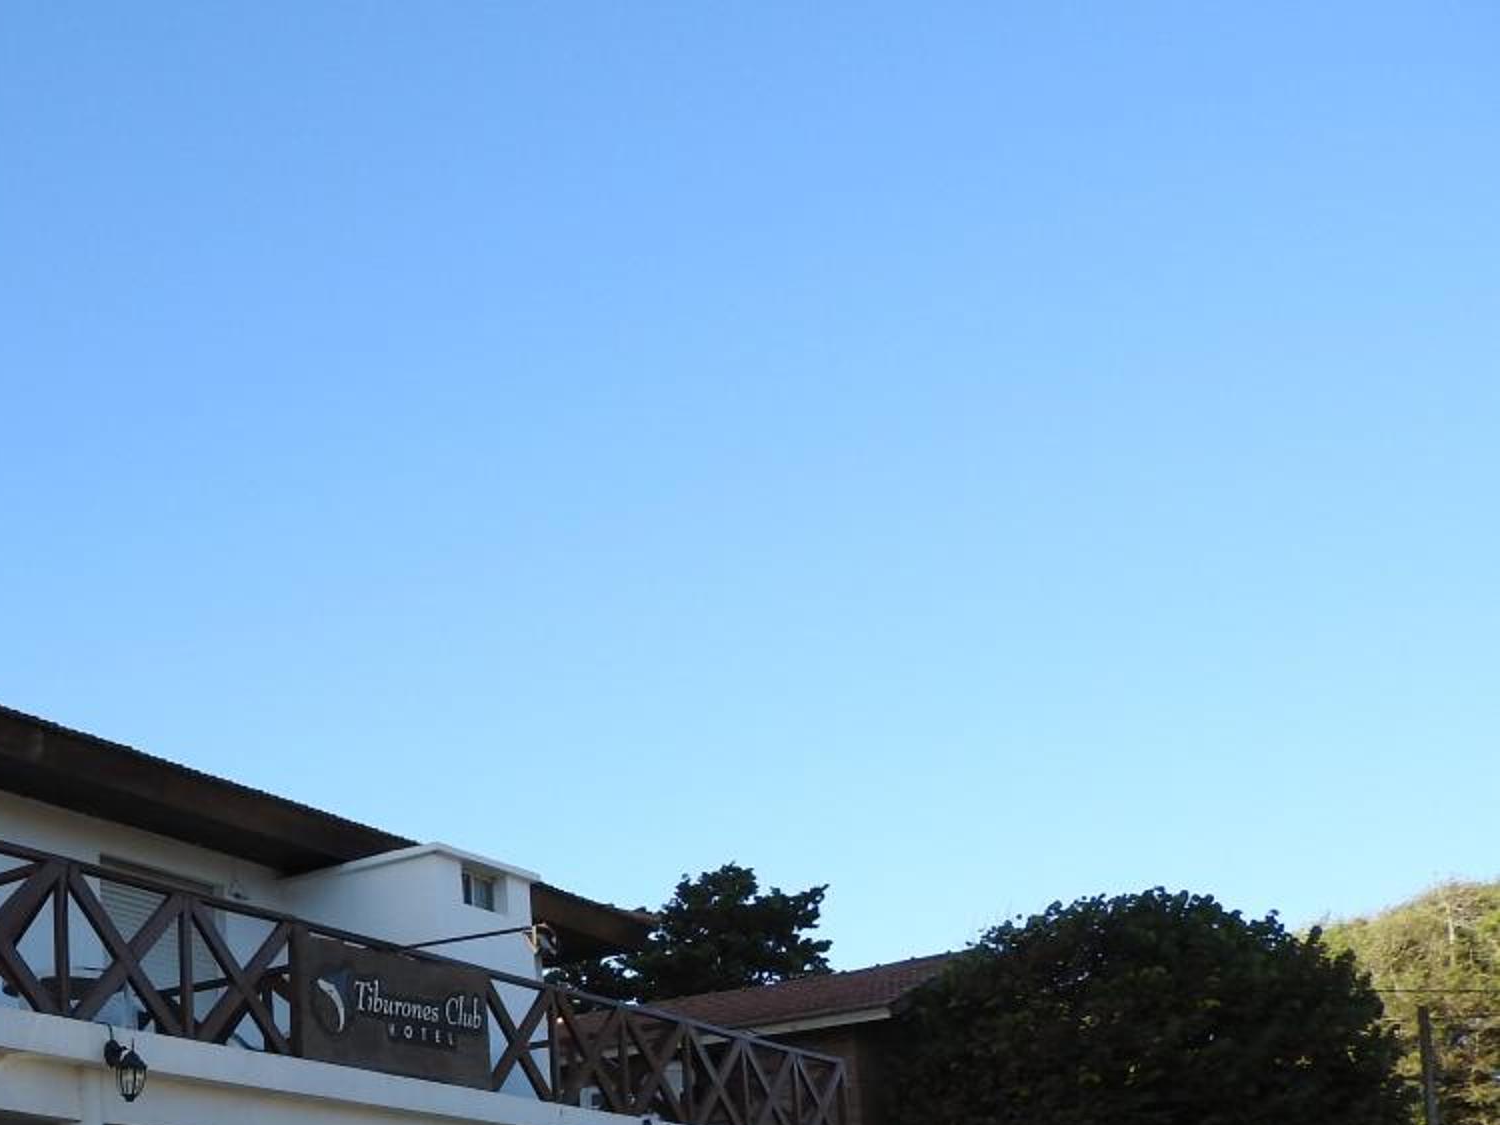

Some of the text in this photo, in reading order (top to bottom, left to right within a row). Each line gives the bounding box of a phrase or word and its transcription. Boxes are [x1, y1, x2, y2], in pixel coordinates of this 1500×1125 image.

[354, 979, 483, 1030] Tiburones Club
[387, 1023, 455, 1045] HOTEL
